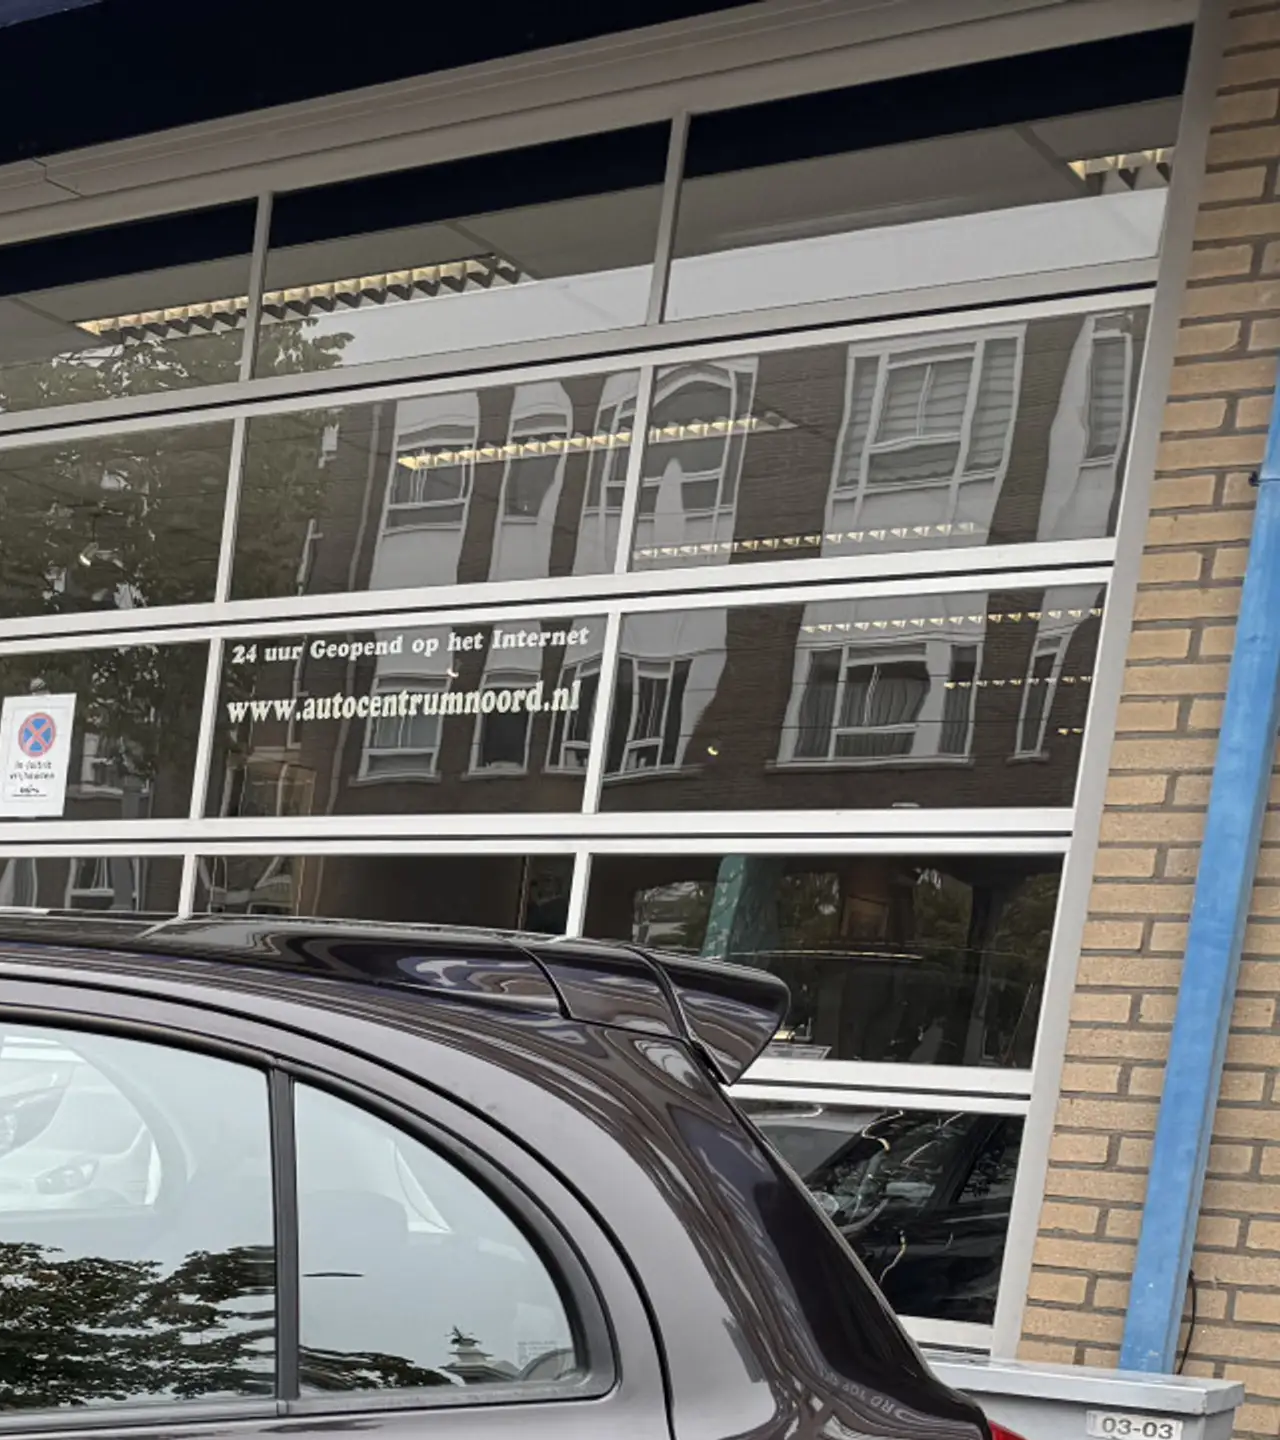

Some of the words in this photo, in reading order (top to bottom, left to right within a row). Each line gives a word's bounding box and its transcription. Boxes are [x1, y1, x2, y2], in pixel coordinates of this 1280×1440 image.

[232, 643, 258, 664] 24
[264, 644, 302, 663] uur
[310, 635, 403, 663] Geopend
[411, 635, 439, 657] op
[447, 630, 484, 652] het
[492, 625, 589, 650] Internet
[227, 681, 579, 724] www.autocentrumnoord.nl
[1101, 1417, 1174, 1440] 03-03
